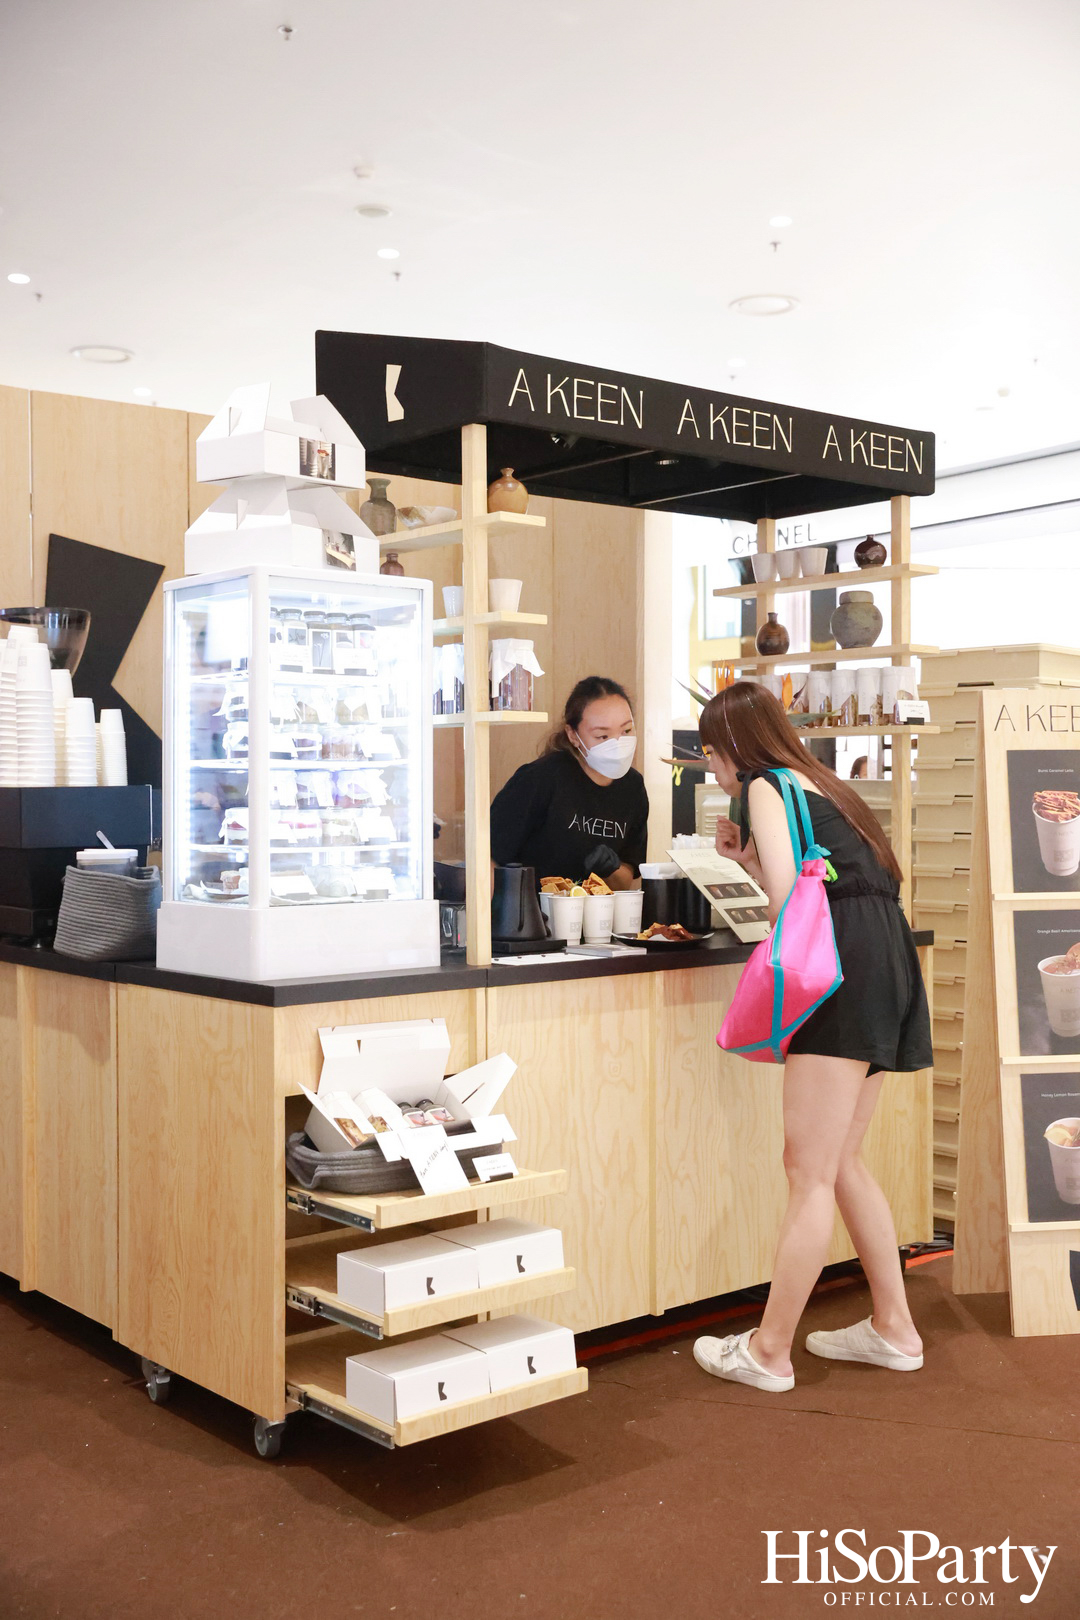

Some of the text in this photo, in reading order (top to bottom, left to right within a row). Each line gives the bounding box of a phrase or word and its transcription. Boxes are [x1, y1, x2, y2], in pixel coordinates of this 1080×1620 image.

[508, 368, 923, 475] A KEEN A KEEN A KEEN
[994, 704, 1016, 732] A
